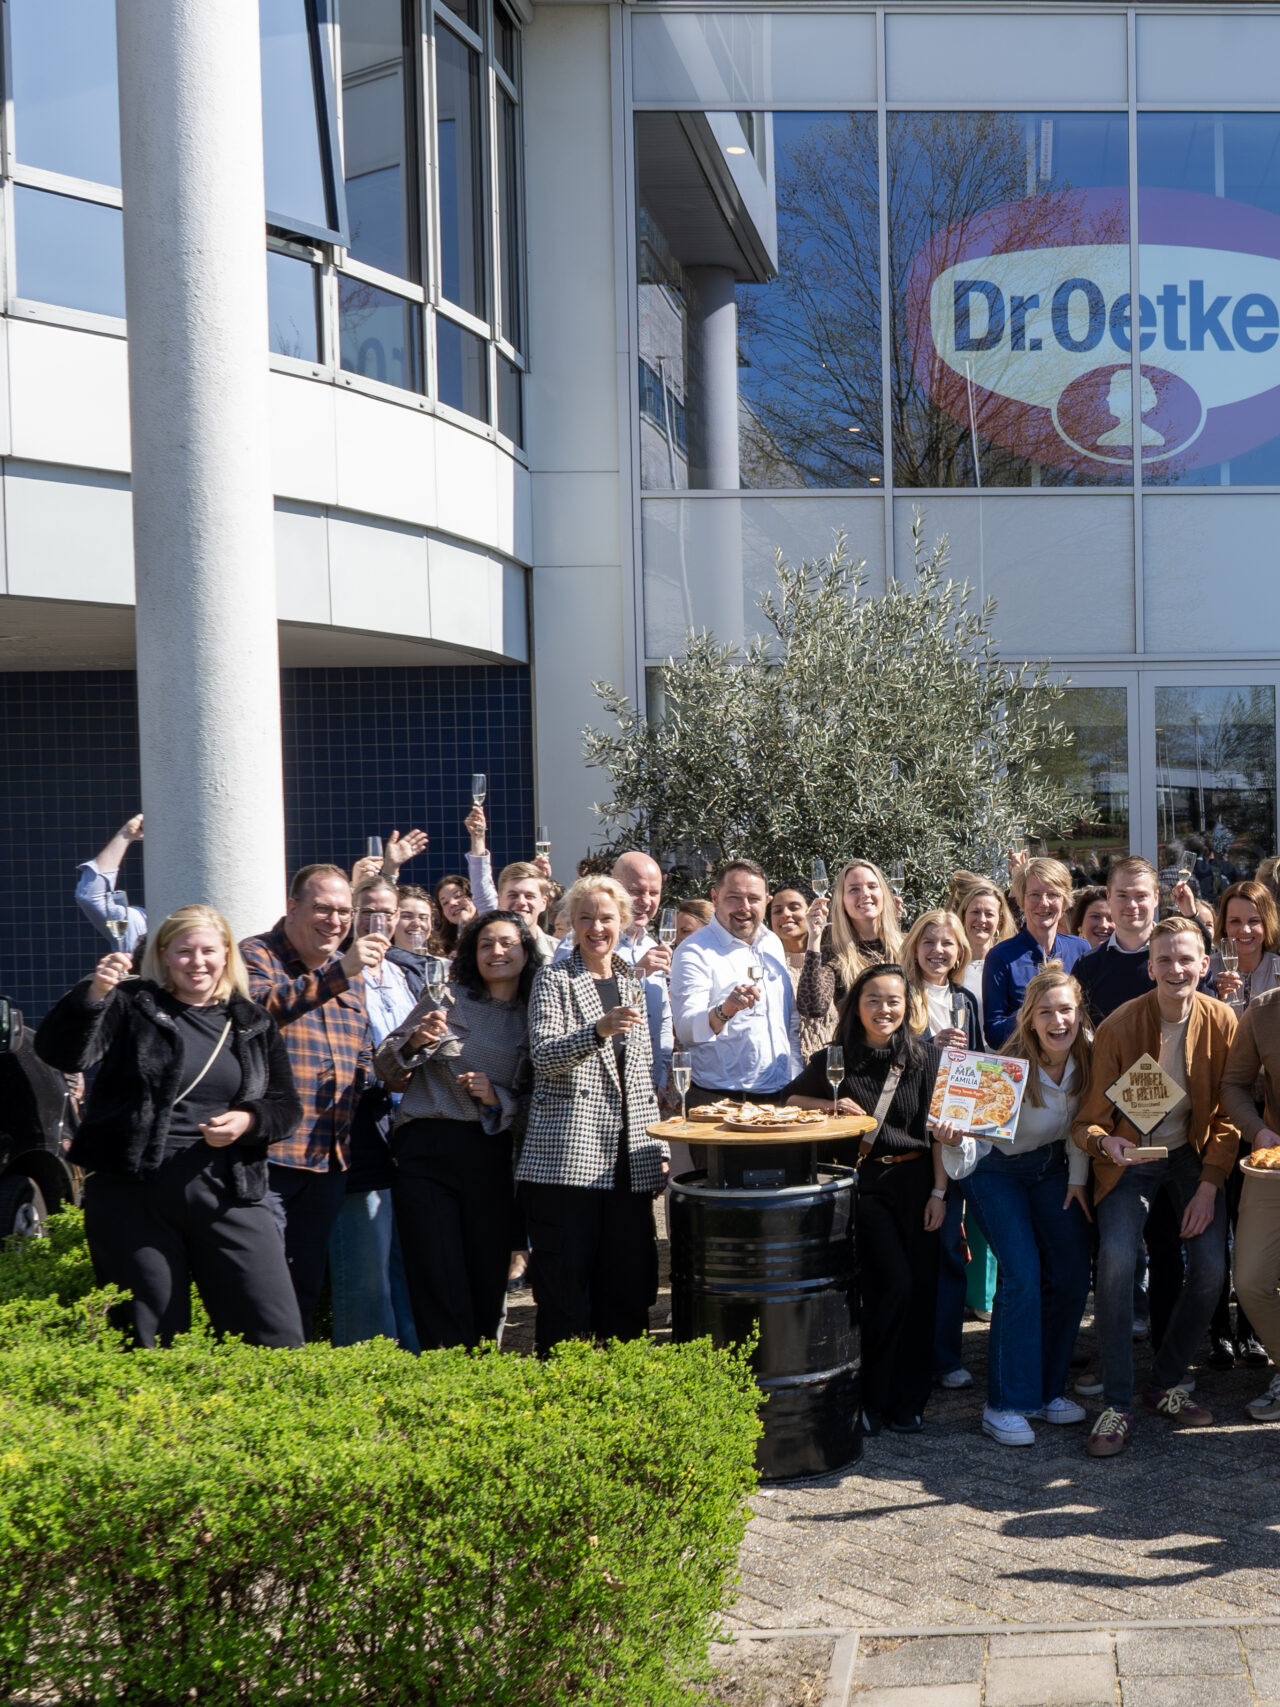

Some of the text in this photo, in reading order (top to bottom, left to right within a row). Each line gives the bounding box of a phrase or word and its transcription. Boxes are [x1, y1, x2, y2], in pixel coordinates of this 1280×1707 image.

[954, 1066, 976, 1078] MIA
[950, 1074, 978, 1085] FAMILIA
[1129, 1072, 1164, 1086] WHEEL
[1122, 1086, 1170, 1102] OF RETAIL
